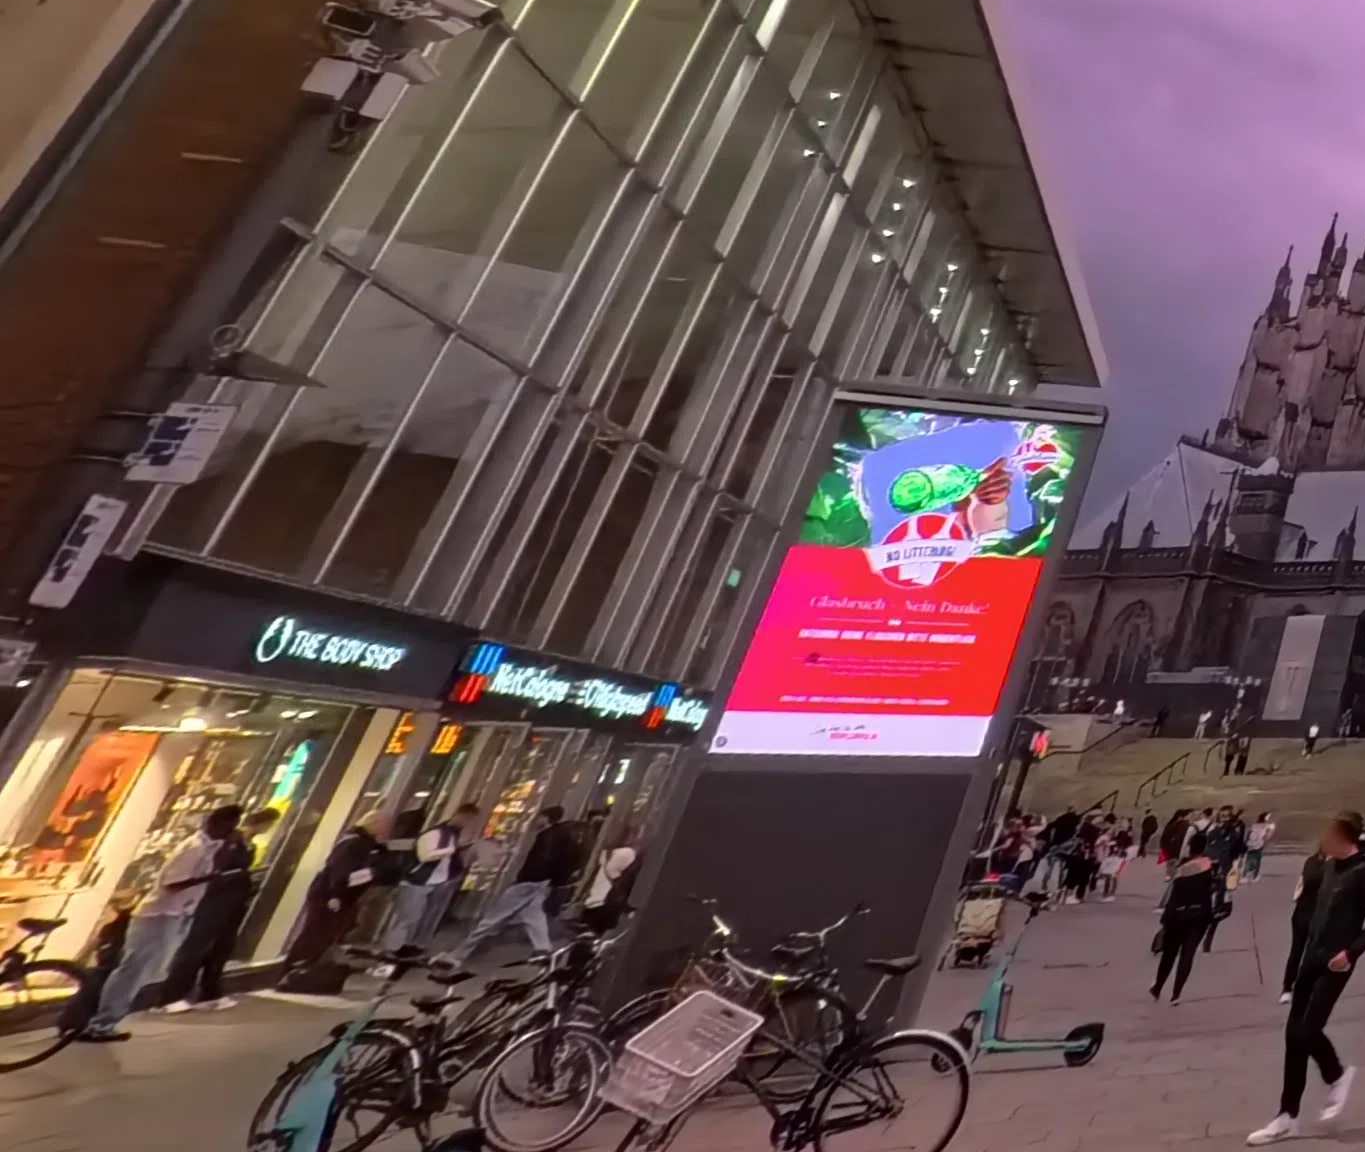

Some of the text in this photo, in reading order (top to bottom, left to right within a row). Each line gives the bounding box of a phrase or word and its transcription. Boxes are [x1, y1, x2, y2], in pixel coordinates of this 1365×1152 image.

[904, 599, 937, 614] Nein
[288, 629, 408, 670] THE BODY SHOP
[488, 662, 571, 708] NetCologne
